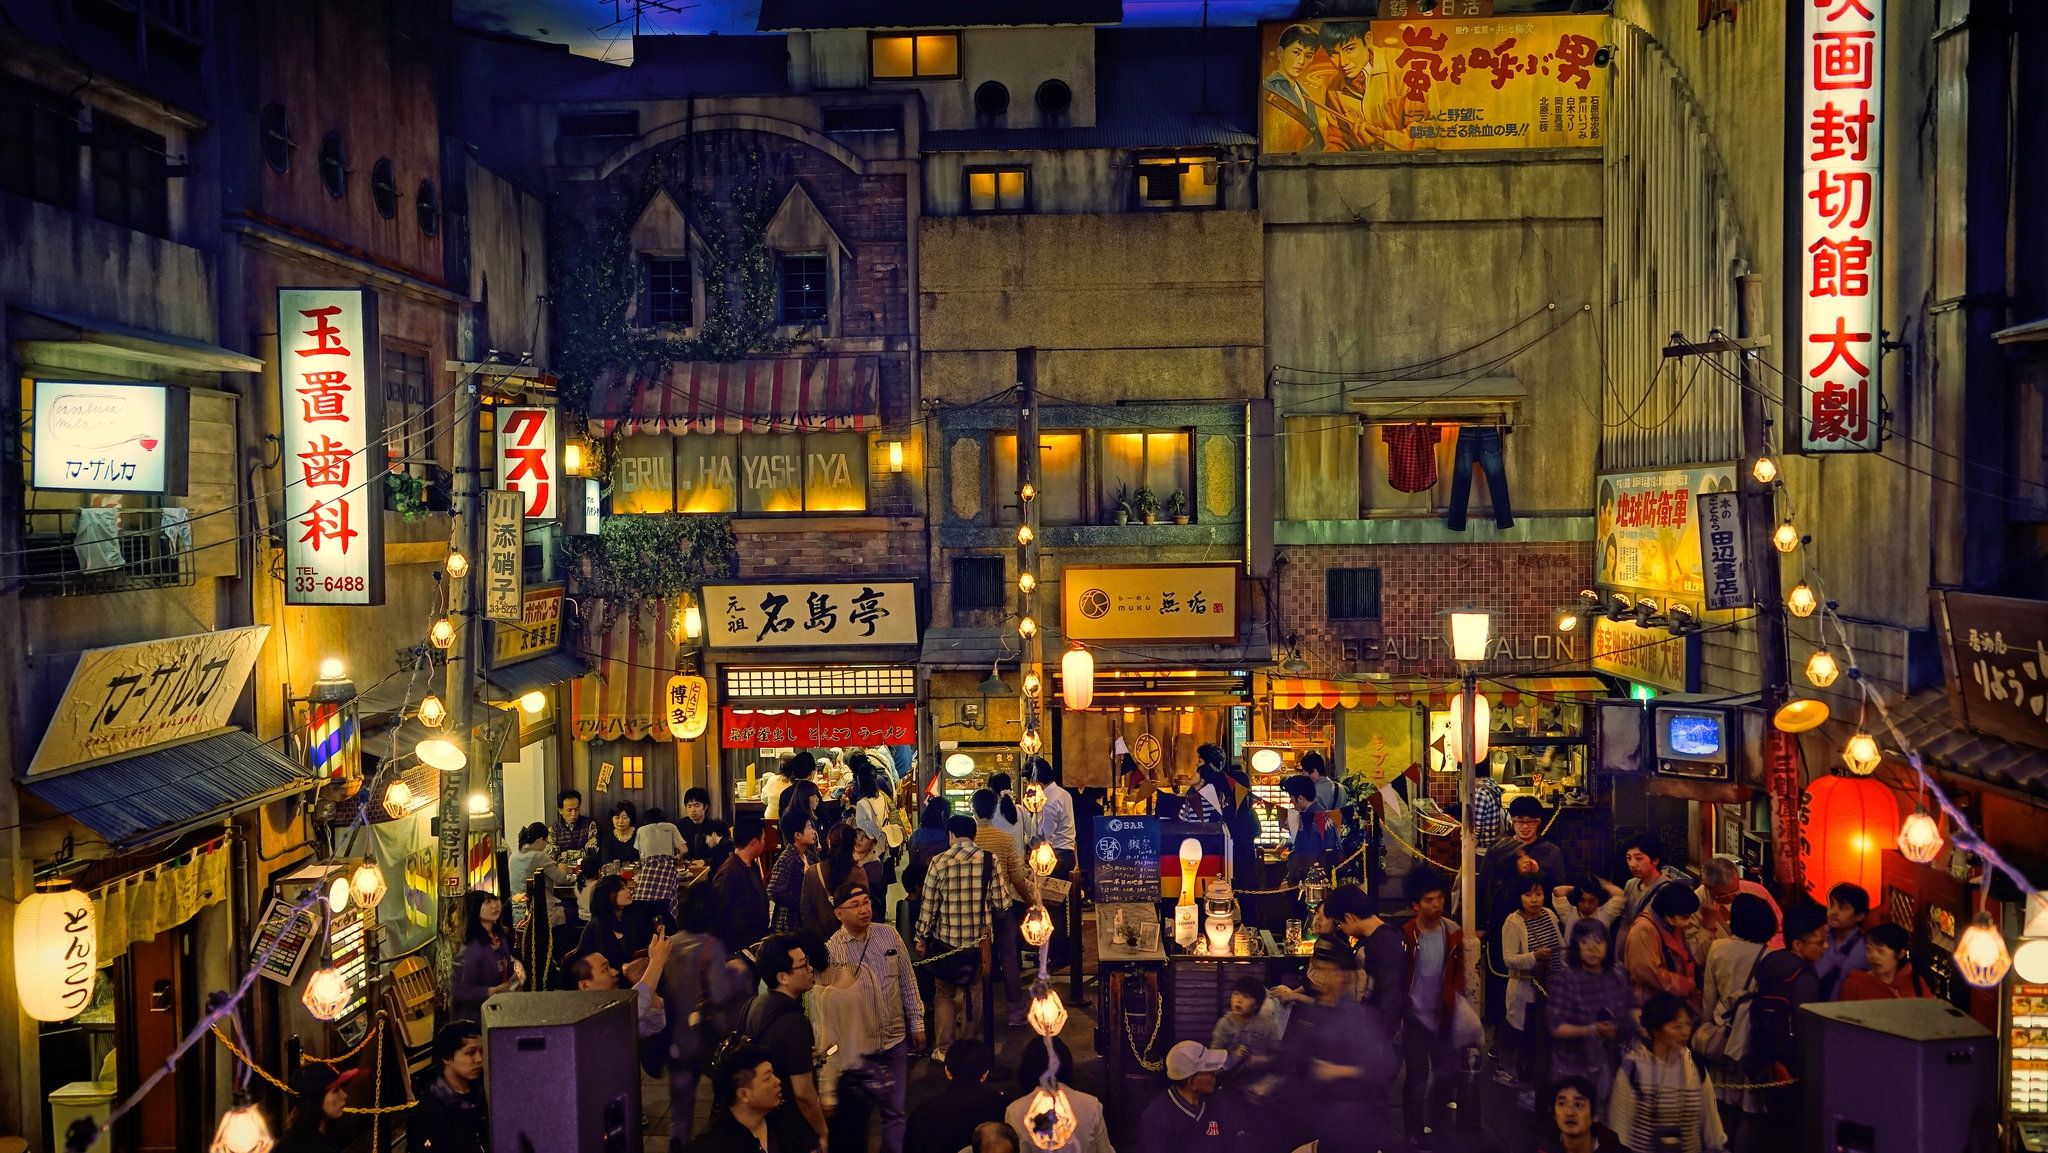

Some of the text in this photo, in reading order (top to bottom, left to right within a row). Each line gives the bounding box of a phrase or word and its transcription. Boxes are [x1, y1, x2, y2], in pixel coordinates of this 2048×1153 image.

[1395, 24, 1599, 103] 嵐を呼ぶ男
[1567, 97, 1575, 131] 白木マリ
[1808, 316, 1873, 443] 大劇
[294, 305, 359, 556] 玉置歯科
[66, 459, 137, 482] カーザルカ
[502, 410, 550, 517] クスリ
[1616, 488, 1689, 530] 地球防衛軍
[491, 496, 518, 601] 川添硝子
[1711, 530, 1739, 596] 田辺書店
[295, 576, 365, 593] 33-6488
[296, 567, 319, 576] TEL
[727, 596, 749, 633] 元祖
[756, 587, 890, 643] 名島亭
[670, 684, 688, 725] 博多
[85, 714, 199, 748] CASA LUCA MILANO
[858, 725, 907, 740] ラーメン
[1123, 821, 1144, 830] BAR
[62, 907, 90, 1009] とんこつ
